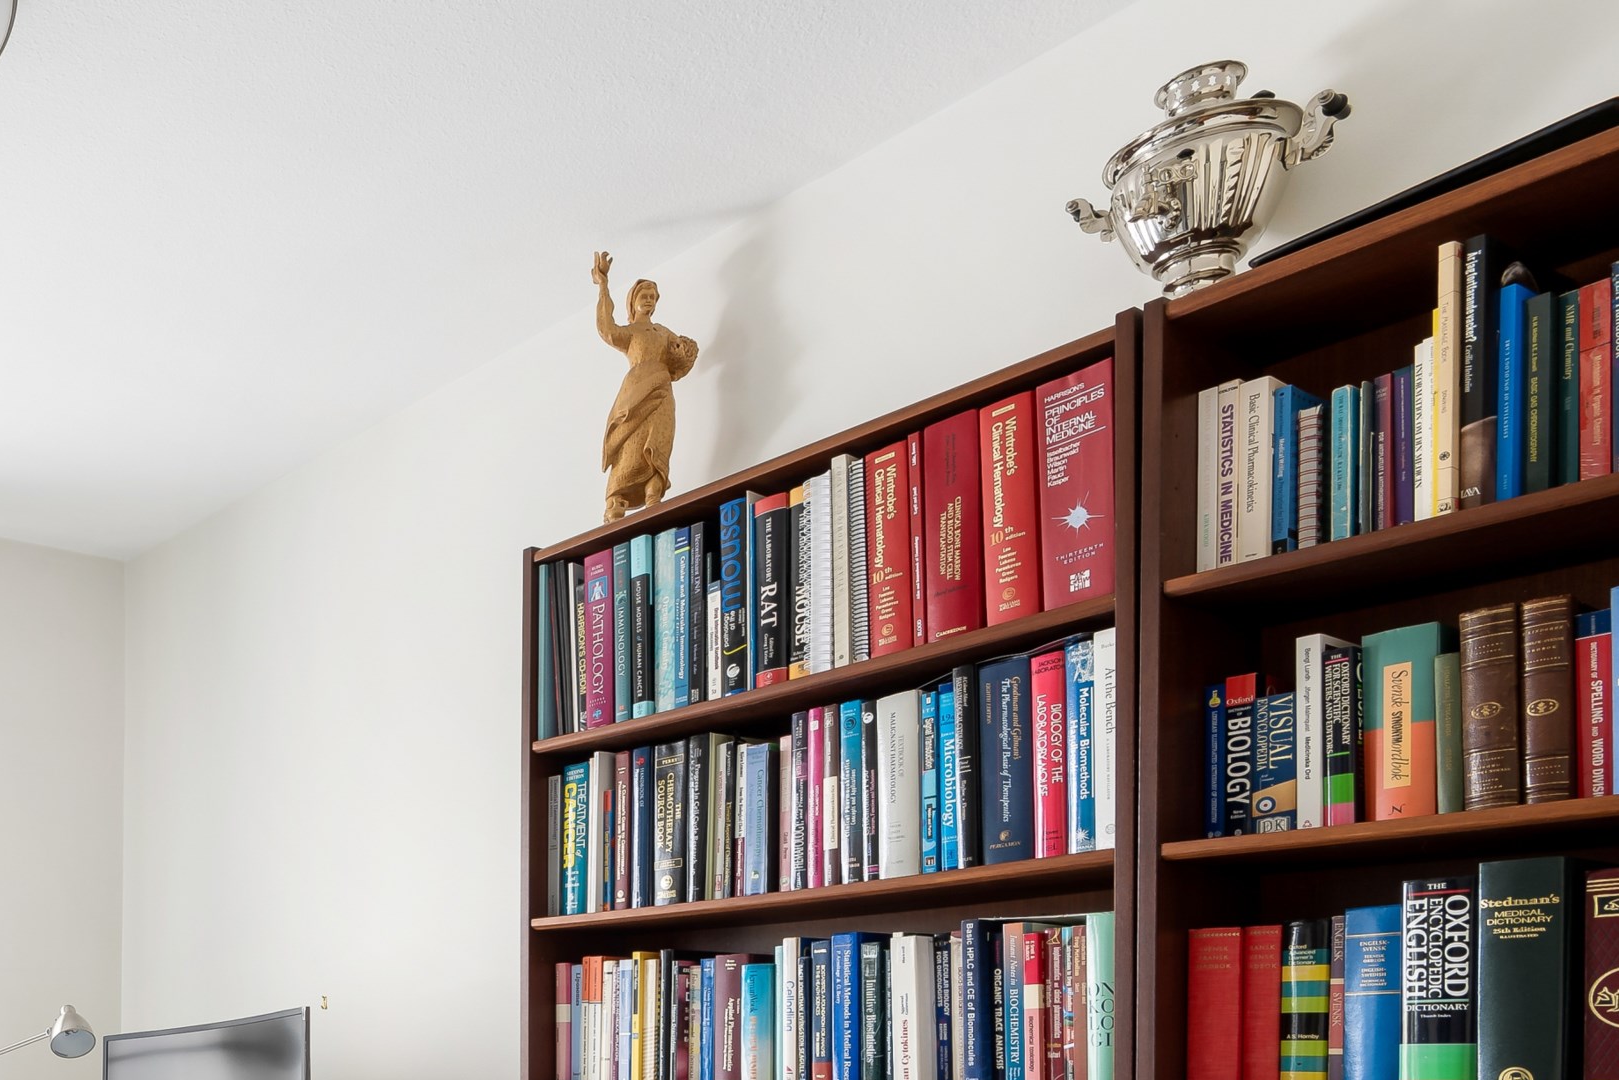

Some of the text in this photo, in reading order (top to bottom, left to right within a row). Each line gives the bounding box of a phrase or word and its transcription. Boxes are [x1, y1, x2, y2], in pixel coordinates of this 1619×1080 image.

[1563, 304, 1575, 380] NMR Chemistry
[1044, 383, 1085, 404] HARRISON'S
[1045, 387, 1104, 419] PRINCIPLES
[1005, 416, 1018, 476] Wintrobe's
[1045, 416, 1061, 428] OF
[1046, 409, 1097, 435] INTERNAL
[1046, 420, 1096, 445] MEDICINE
[992, 421, 1006, 527] Clinical Hematology
[1047, 458, 1068, 469] Wilson
[1047, 464, 1067, 475] Martin
[1246, 392, 1260, 514] Basic Clinical Pharmacokinetics
[887, 464, 896, 519] Wintrobe's
[1048, 475, 1070, 487] Kasper
[1220, 403, 1234, 564] STATISTICS IN MEDICINE
[875, 469, 885, 567] Clinical Hematology
[990, 531, 1004, 546] 10
[720, 501, 741, 613] mouse
[872, 571, 884, 585] 10
[1055, 542, 1104, 562] THIRTEENTH
[1064, 550, 1096, 565] EDITION
[577, 602, 586, 658] HARRISON'S
[761, 582, 778, 627] RAT
[592, 602, 605, 695] PATHOLOGY
[618, 606, 626, 677] IMMUNOLOGY
[1226, 694, 1254, 706] Oxford
[1325, 666, 1334, 755] WRITERS EDITORS
[1333, 663, 1341, 723] FOR SCIENTIFIC
[1341, 661, 1351, 746] OXFORD DICTIONARY
[1391, 669, 1409, 708] Svensk
[1036, 695, 1048, 758] LABORATORY
[1050, 704, 1063, 783] BIOLOGY THE
[1079, 687, 1090, 800] Molecular Biomethods
[1105, 700, 1116, 734] Bench
[1256, 697, 1268, 772] ENCYCLOPEDIA
[1269, 693, 1294, 771] VISUAL
[1591, 679, 1604, 798] SPELLING WORD DIVISI
[943, 739, 956, 827] Microbiology
[1226, 716, 1252, 804] BIOLOGY
[563, 783, 577, 869] CANCER
[576, 781, 587, 848] TREATMENT
[657, 780, 665, 818] SOURCE
[665, 772, 675, 853] CHEMOTHERAPY
[1427, 882, 1447, 890] THE
[1480, 894, 1560, 909] Stedman's
[1494, 908, 1545, 919] MEDICAL
[1332, 920, 1343, 962] ENGELSK
[1406, 897, 1427, 999] ENGLISH
[1428, 897, 1443, 998] ENCYCLOPEDIC
[1444, 894, 1470, 997] OXFORD
[1486, 915, 1553, 927] DICTIONARY
[1512, 926, 1546, 934] Edition
[967, 968, 975, 986] and
[968, 988, 975, 1000] CE
[865, 979, 877, 1064] Intuitive Biostatistics
[994, 968, 1004, 1069] ORGANIC TRACE ANALYSIS
[1010, 988, 1019, 1064] BIOCHEMISTRY
[1331, 992, 1341, 1027] SVENSK
[1406, 1003, 1470, 1012] DICTIONARY
[901, 1020, 910, 1066] Cytokines
[968, 1012, 976, 1066] Biomolecules
[1298, 1032, 1320, 1040] Hornby
